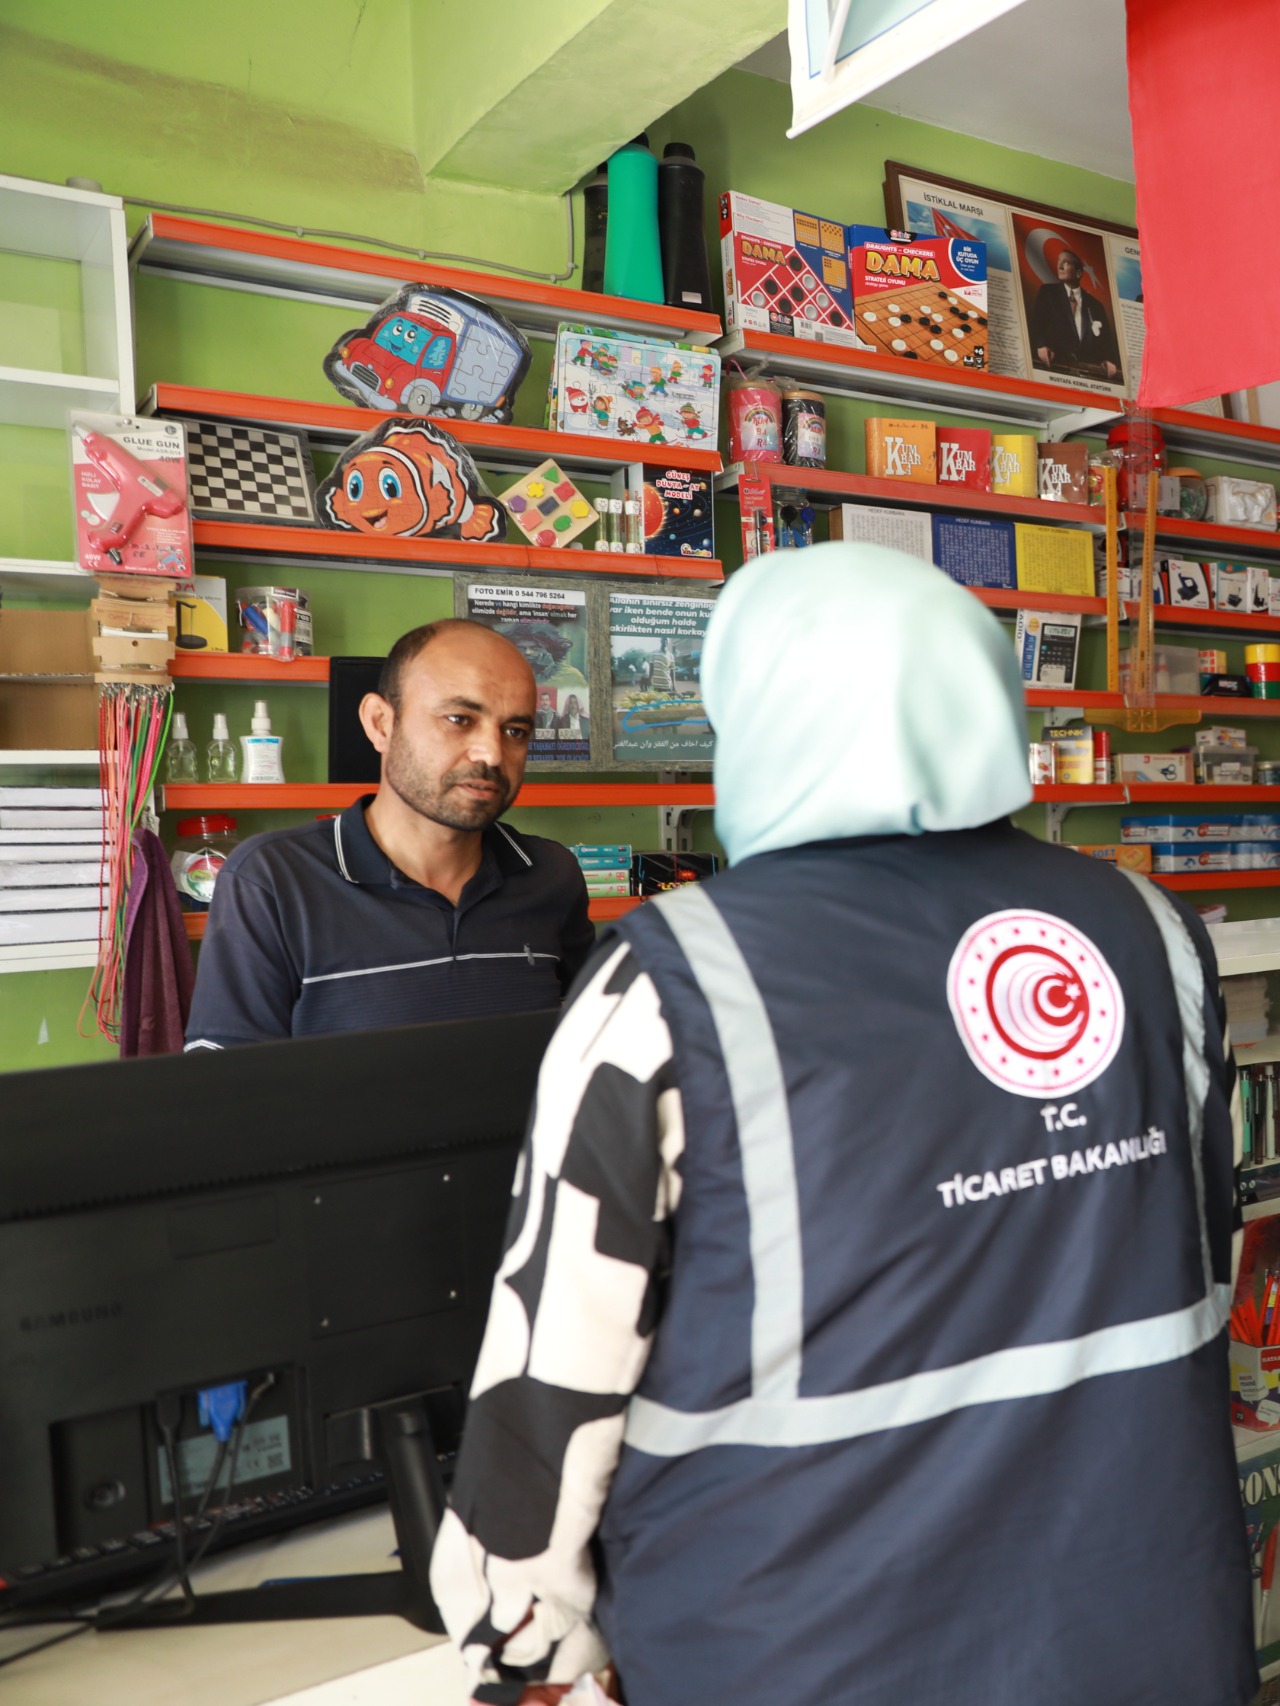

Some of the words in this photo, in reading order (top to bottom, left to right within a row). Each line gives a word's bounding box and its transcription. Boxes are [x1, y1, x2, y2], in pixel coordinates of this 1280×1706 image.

[923, 192, 957, 209] İSTİKLAL
[959, 202, 984, 216] MARŞI
[741, 240, 787, 266] DAMA
[866, 243, 897, 252] DRAUGHTS
[903, 248, 934, 257] CHECKERS
[866, 251, 941, 281] DAMA
[1049, 376, 1072, 385] MUSTAFA
[1073, 380, 1089, 388] KEMAL
[1090, 383, 1111, 392] ATATÜRK
[123, 436, 153, 447] GLUE
[156, 439, 180, 449] GUN
[666, 470, 691, 482] GÜNEŞ
[656, 478, 682, 489] DÜNYA
[689, 483, 700, 491] AY
[664, 489, 693, 500] MODELİ
[496, 588, 513, 596] EMİR
[502, 601, 519, 609] hangi
[624, 606, 643, 615] iken
[645, 607, 673, 616] bende
[675, 610, 697, 618] onun
[630, 616, 670, 626] olduğum
[671, 618, 697, 627] halde
[610, 625, 652, 633] akirlikten
[654, 627, 676, 635] nasıl
[677, 628, 706, 637] korkay
[1049, 729, 1084, 738] TECHNIK
[1091, 848, 1117, 859] SOFT
[1040, 1102, 1087, 1132] T.C.
[936, 1158, 1048, 1208] TİCARET
[1051, 1126, 1167, 1180] BAKANLIĞI
